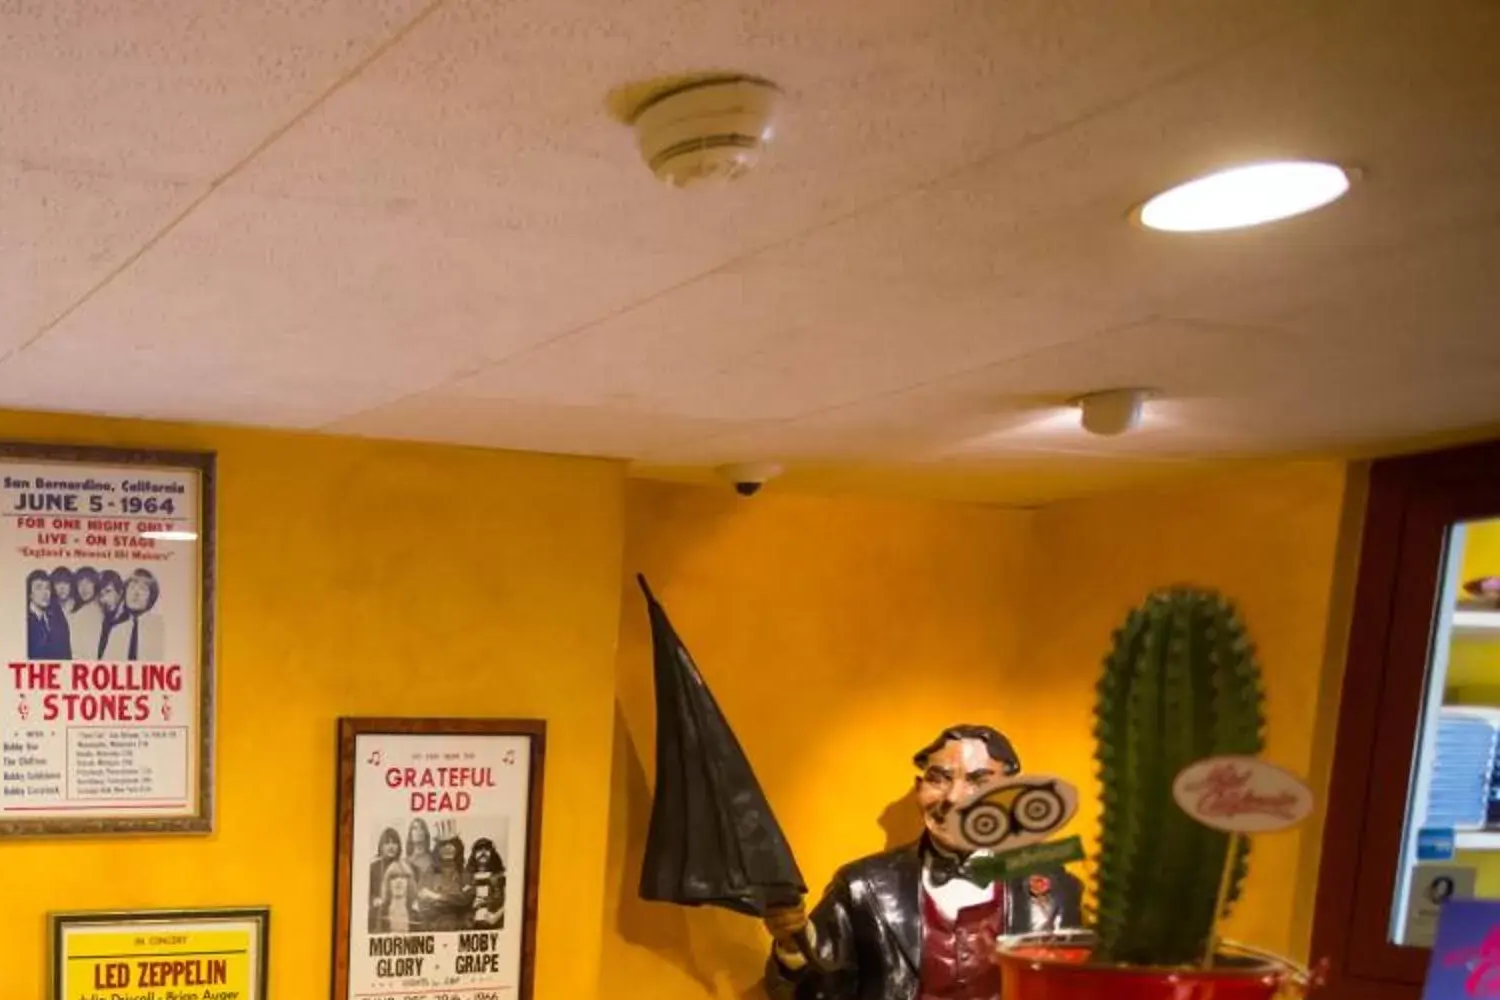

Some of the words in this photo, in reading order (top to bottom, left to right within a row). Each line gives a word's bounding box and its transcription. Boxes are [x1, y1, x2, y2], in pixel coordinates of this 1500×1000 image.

[3, 476, 30, 489] San
[35, 477, 115, 493] Bernardino,
[121, 480, 185, 494] California
[14, 493, 78, 511] JUNE
[89, 495, 103, 512] 5
[121, 497, 175, 515] 1964
[17, 517, 45, 529] FOR
[52, 519, 81, 531] ONE
[87, 520, 132, 532] NIGHT
[37, 533, 68, 545] LIVE
[85, 535, 107, 547] ON
[113, 535, 156, 548] STAGE
[8, 663, 62, 689] THE
[72, 663, 182, 692] ROLLING
[43, 694, 150, 721] STONES
[385, 767, 496, 788] GRATEFUL
[410, 792, 471, 812] DEAD
[369, 935, 435, 957] MORNING
[458, 933, 499, 953] MOBY
[95, 963, 130, 990] LED
[137, 960, 227, 988] ZEPPELIN
[377, 958, 424, 978] GLORY
[455, 954, 500, 974] GRAPE
